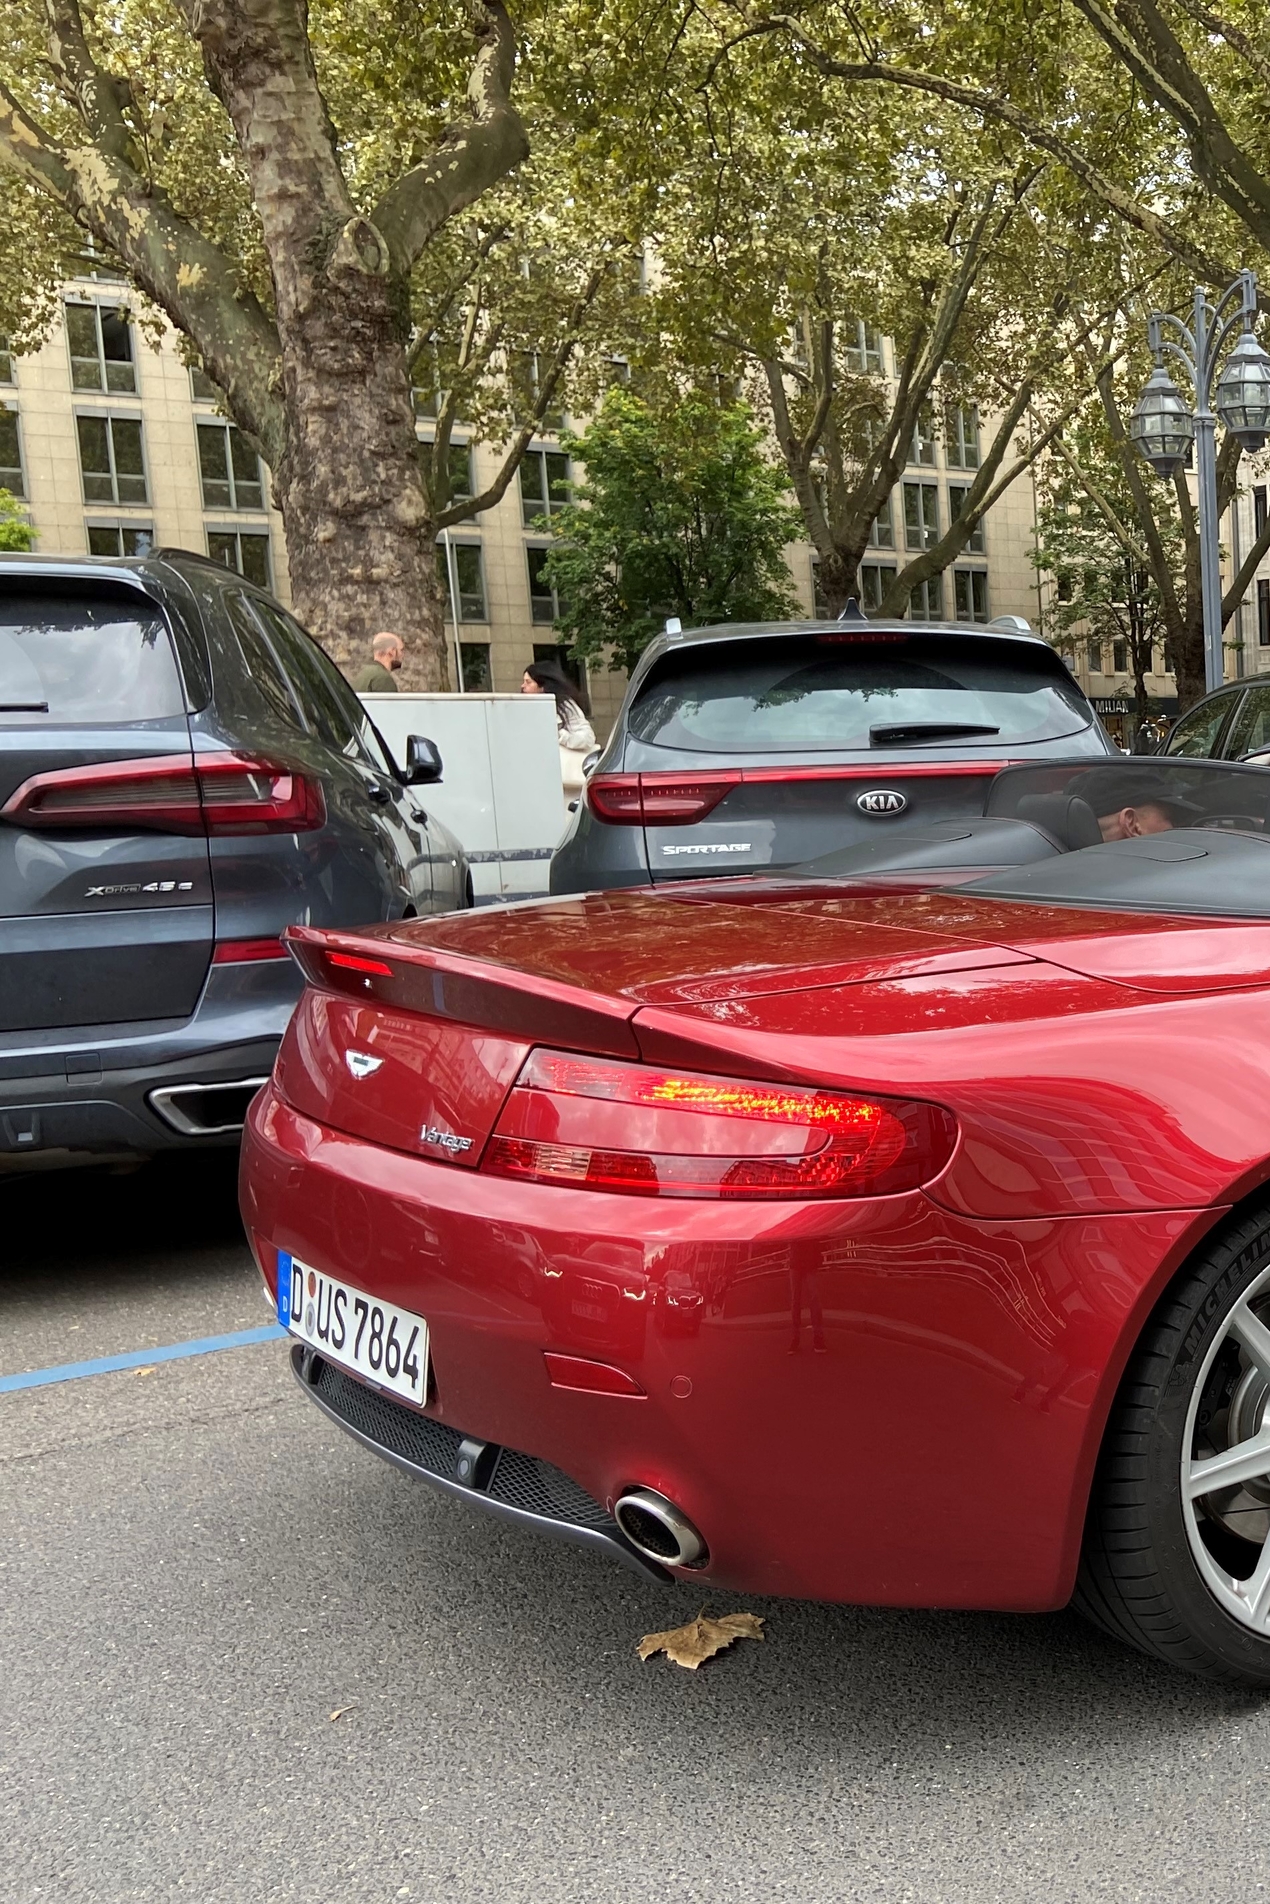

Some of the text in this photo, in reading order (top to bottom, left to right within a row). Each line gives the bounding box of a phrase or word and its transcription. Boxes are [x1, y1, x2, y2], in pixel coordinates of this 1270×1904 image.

[864, 794, 900, 810] KIA
[662, 843, 752, 855] SPORTAGE
[420, 1124, 471, 1153] Vantage
[291, 1263, 420, 1390] D US 7864
